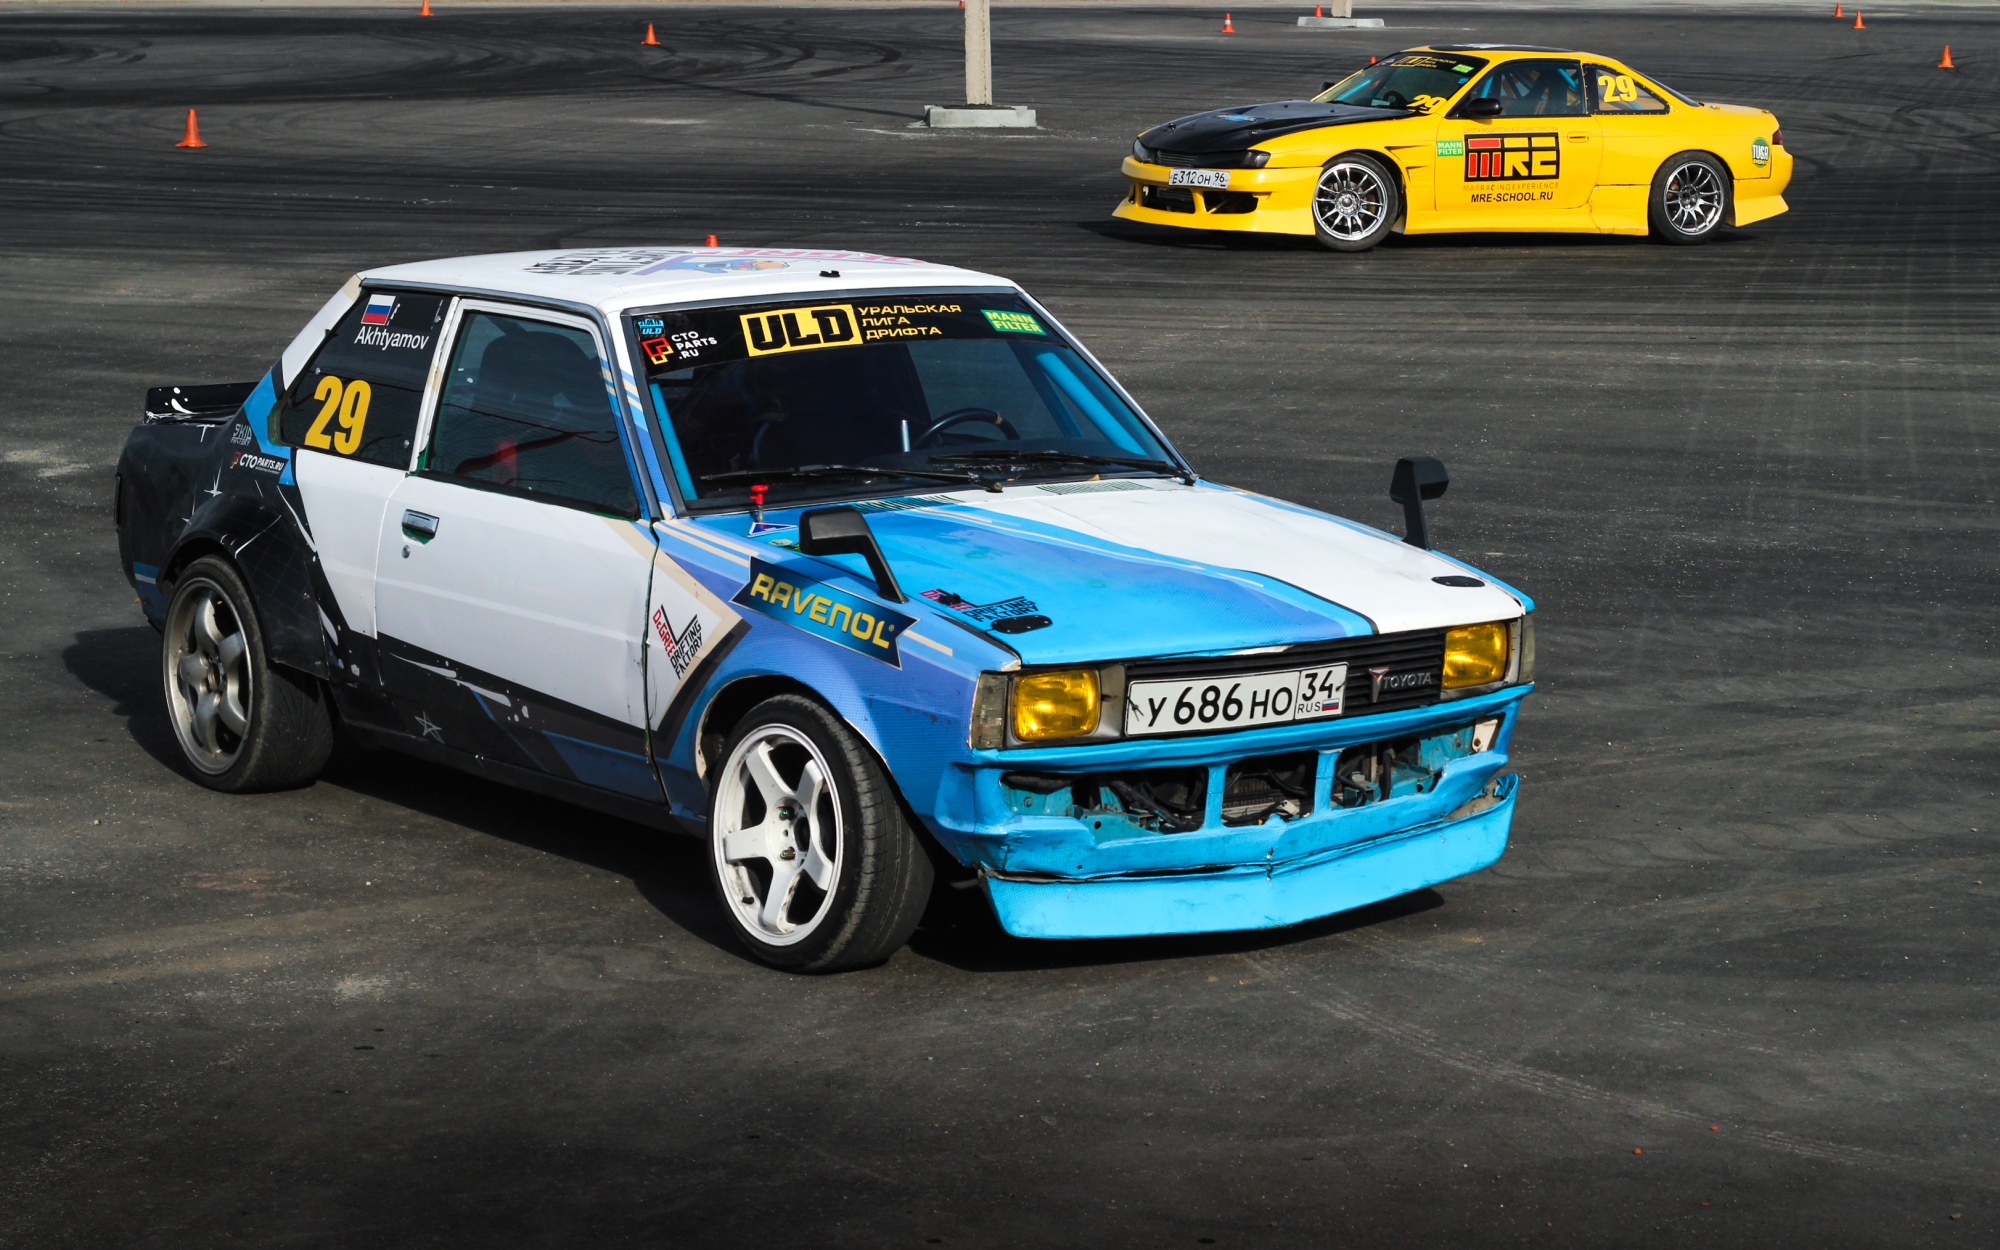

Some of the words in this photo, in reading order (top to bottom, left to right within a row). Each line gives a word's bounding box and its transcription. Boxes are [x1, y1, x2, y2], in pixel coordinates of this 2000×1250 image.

[1598, 75, 1638, 103] 29
[1471, 192, 1553, 203] MRE-SCHOOL.RU
[858, 304, 962, 316] УРАЛЬСКАЯ
[985, 311, 1036, 324] MANN
[746, 307, 855, 351] ULD
[862, 316, 911, 327] ЛИГА
[992, 320, 1043, 333] FILTER
[354, 326, 429, 351] Akhtyamov
[866, 327, 942, 340] ДРИФТА
[675, 337, 718, 351] PARTS
[679, 349, 699, 359] .RU
[304, 375, 371, 455] 29
[750, 573, 889, 649] RAVENOL
[961, 598, 1036, 618] DRIFTING
[669, 619, 702, 669] DRIFTING
[675, 632, 702, 680] FACTORY
[1301, 669, 1334, 701] 34
[1383, 672, 1432, 690] TOYOTA
[1297, 701, 1321, 714] RUS
